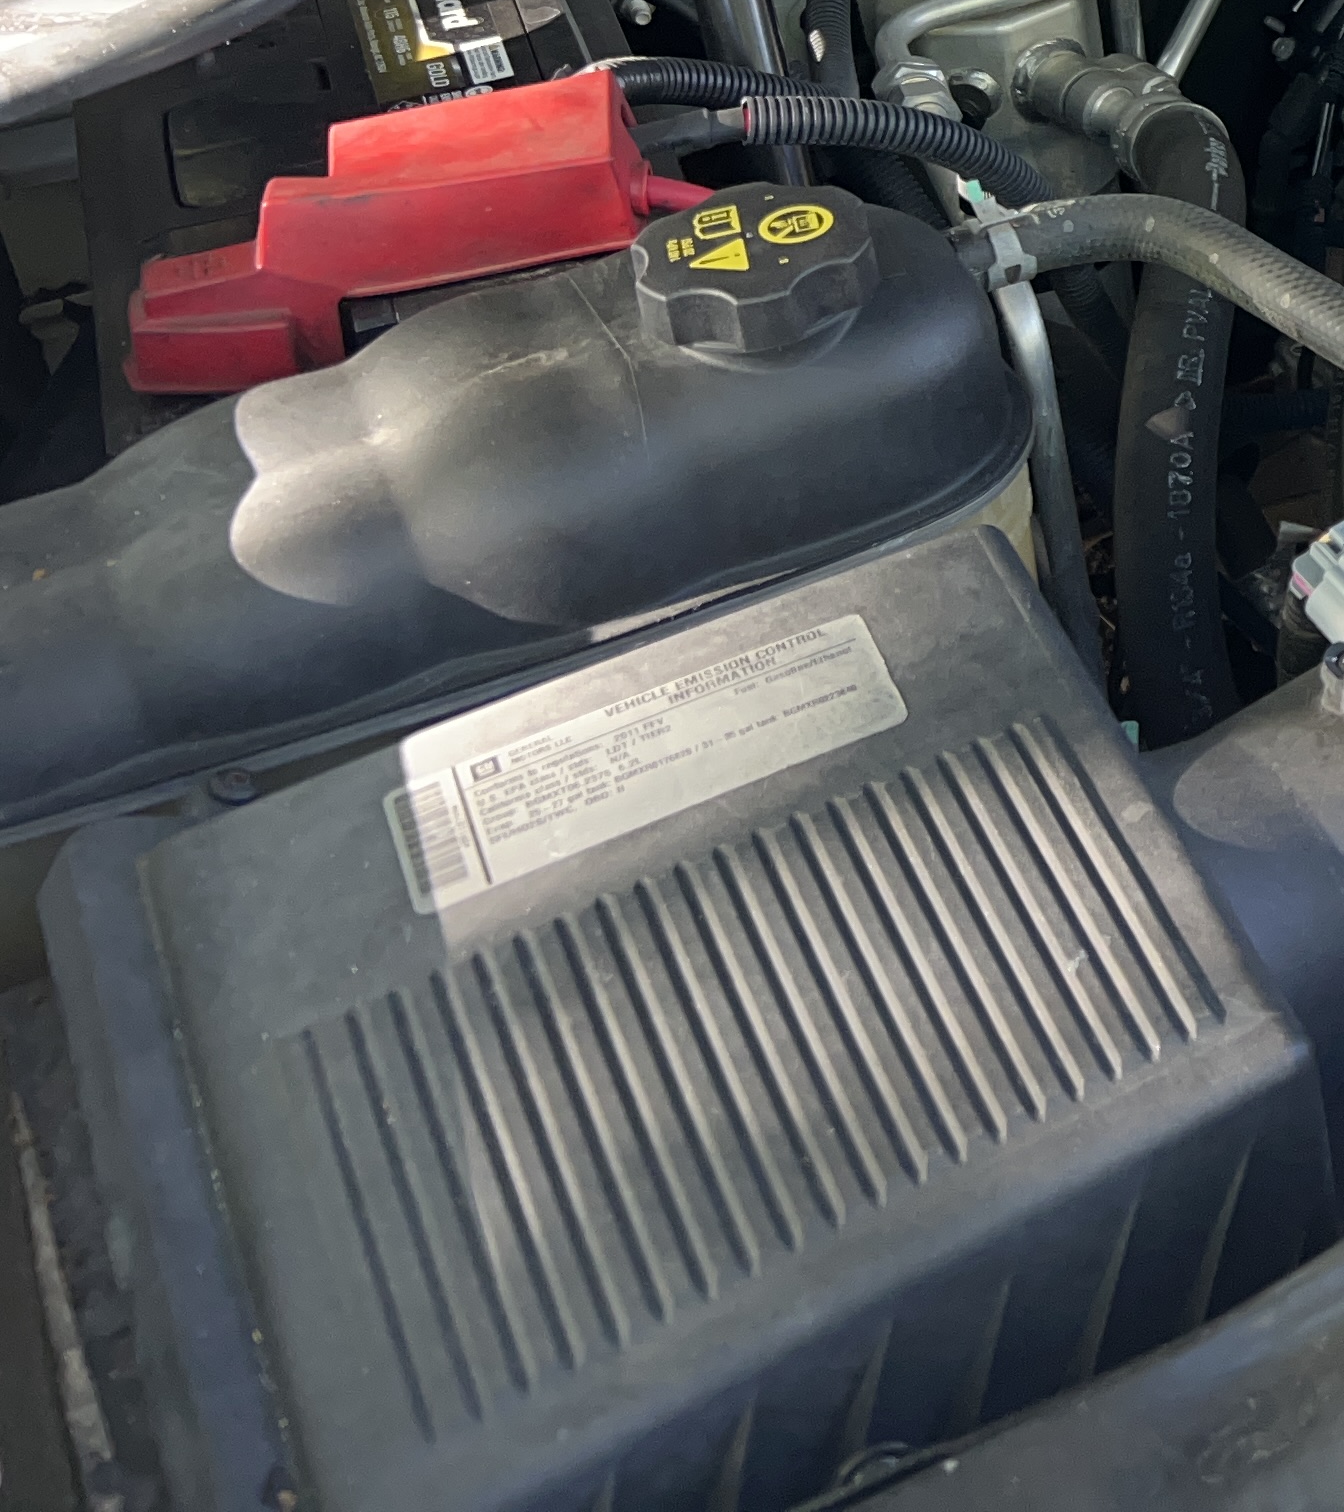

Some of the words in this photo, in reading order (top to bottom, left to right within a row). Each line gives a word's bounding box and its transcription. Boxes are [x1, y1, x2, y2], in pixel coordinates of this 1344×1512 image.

[424, 61, 450, 87] GOLD
[603, 684, 670, 719] VEHICLE
[673, 653, 751, 692] EMISSION
[753, 625, 828, 661] CONTROL
[666, 654, 778, 706] INFORMATION
[612, 725, 641, 743] 2011
[641, 715, 666, 732] FFV
[639, 723, 673, 743] TIER2
[608, 749, 631, 765] N/A
